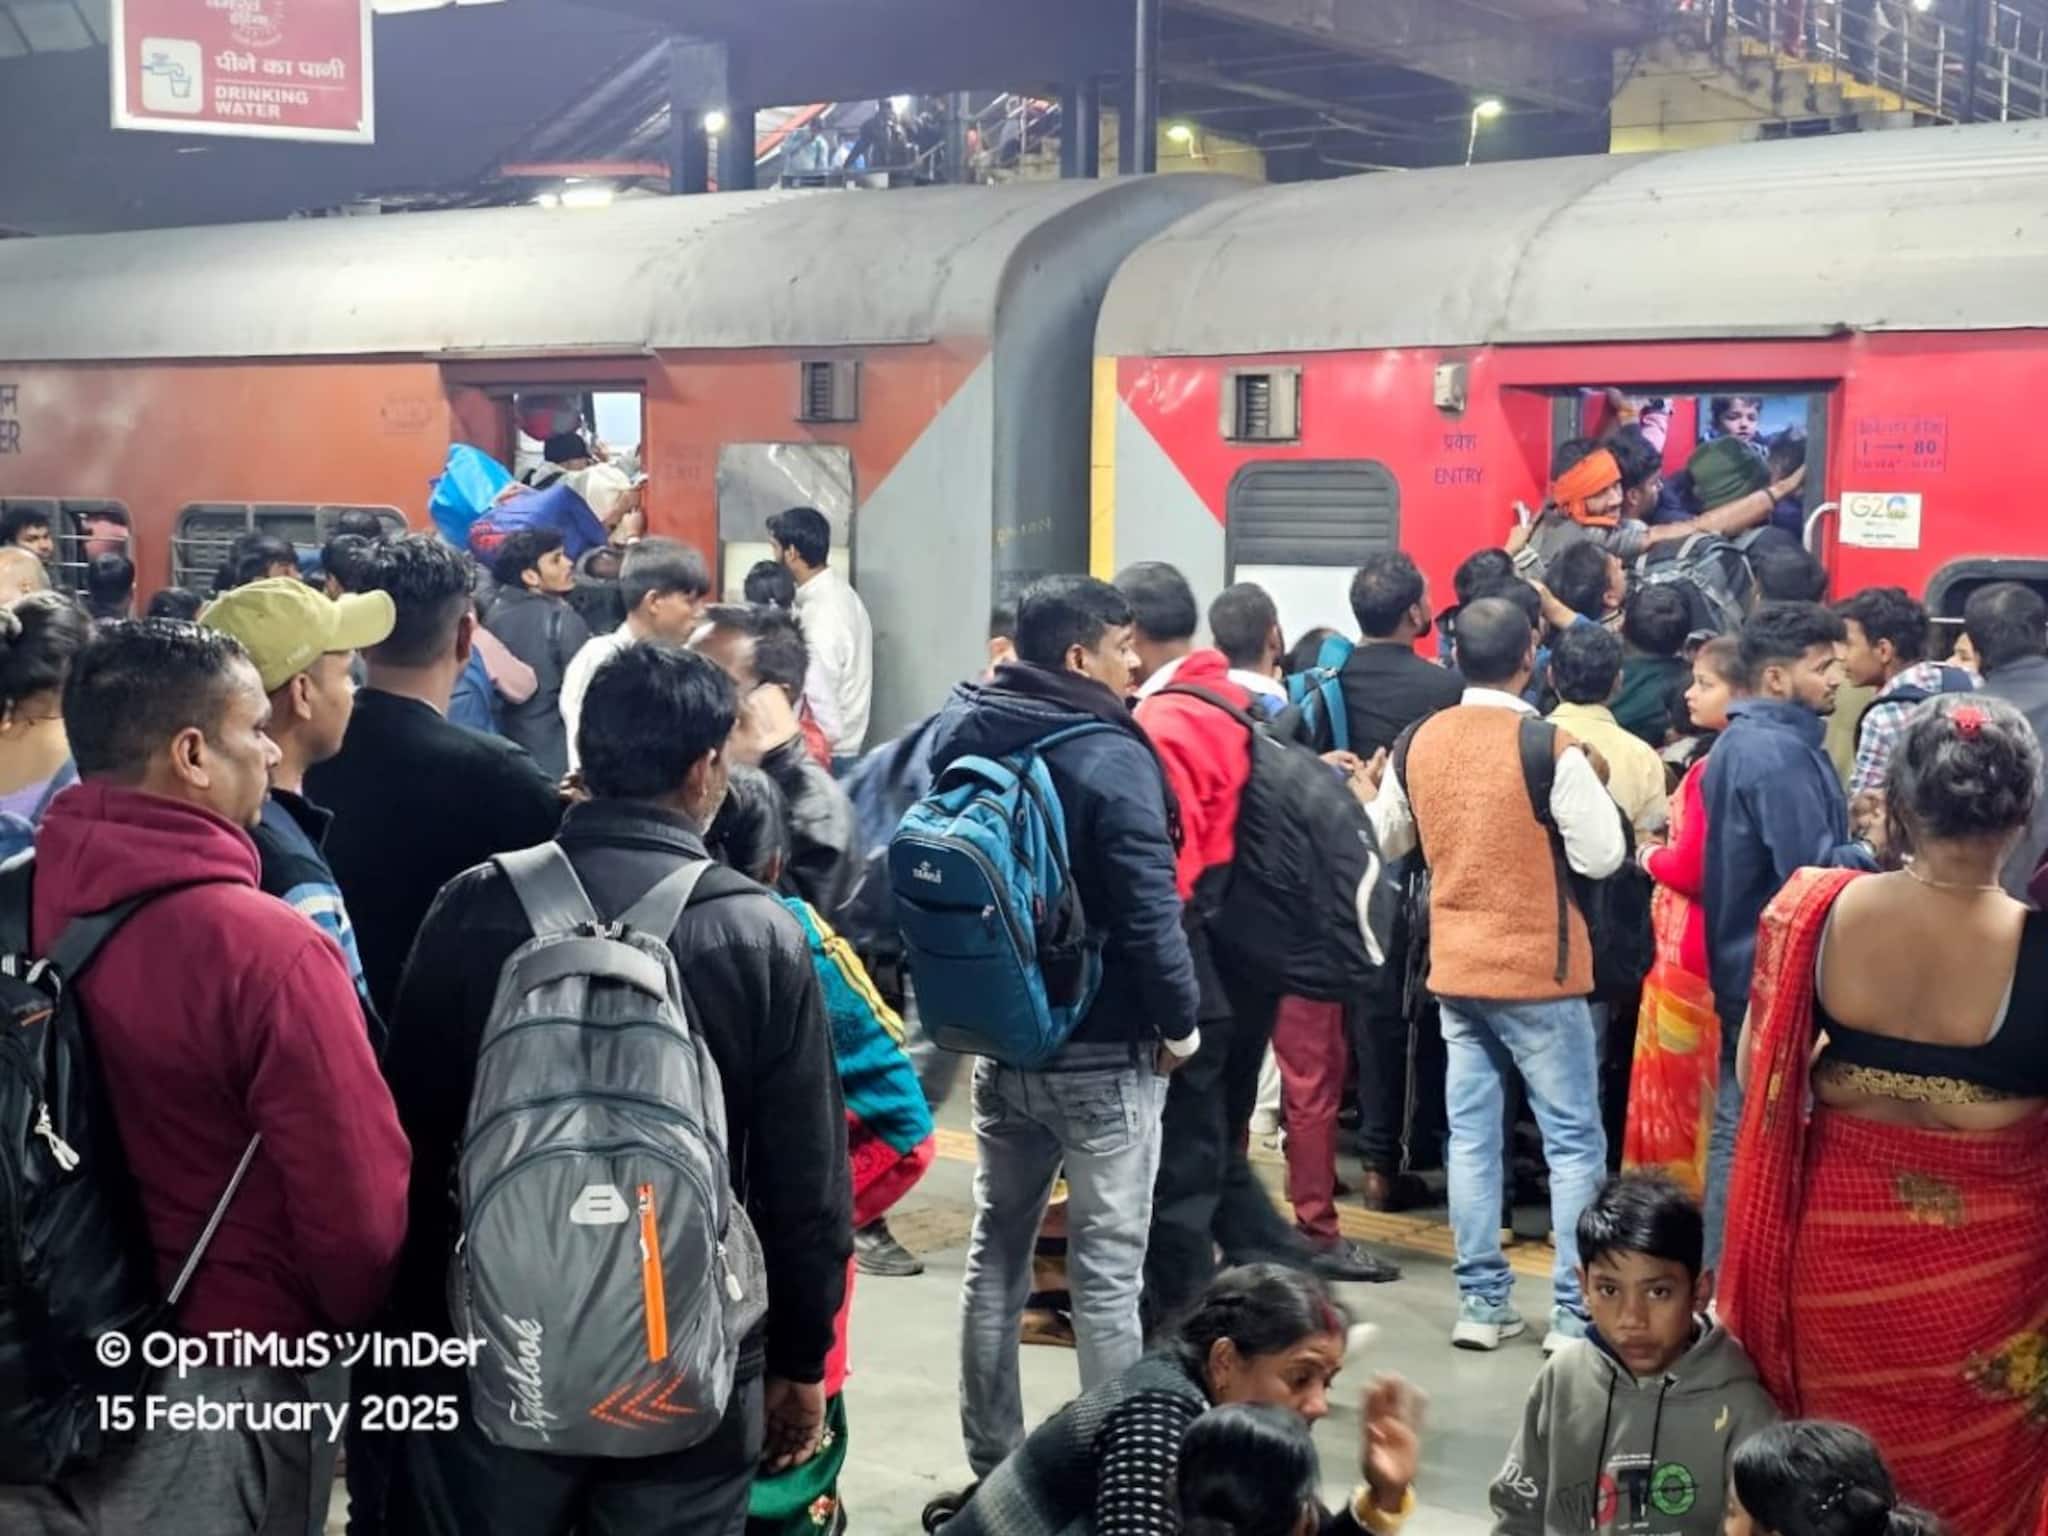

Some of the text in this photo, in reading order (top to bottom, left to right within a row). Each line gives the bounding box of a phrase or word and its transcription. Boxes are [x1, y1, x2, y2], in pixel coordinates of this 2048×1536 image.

[214, 50, 346, 79] पीने का पानी
[215, 84, 309, 105] DRINKING
[215, 100, 281, 118] WATER
[1914, 439, 1937, 455] 80
[1434, 467, 1483, 485] ENTRY
